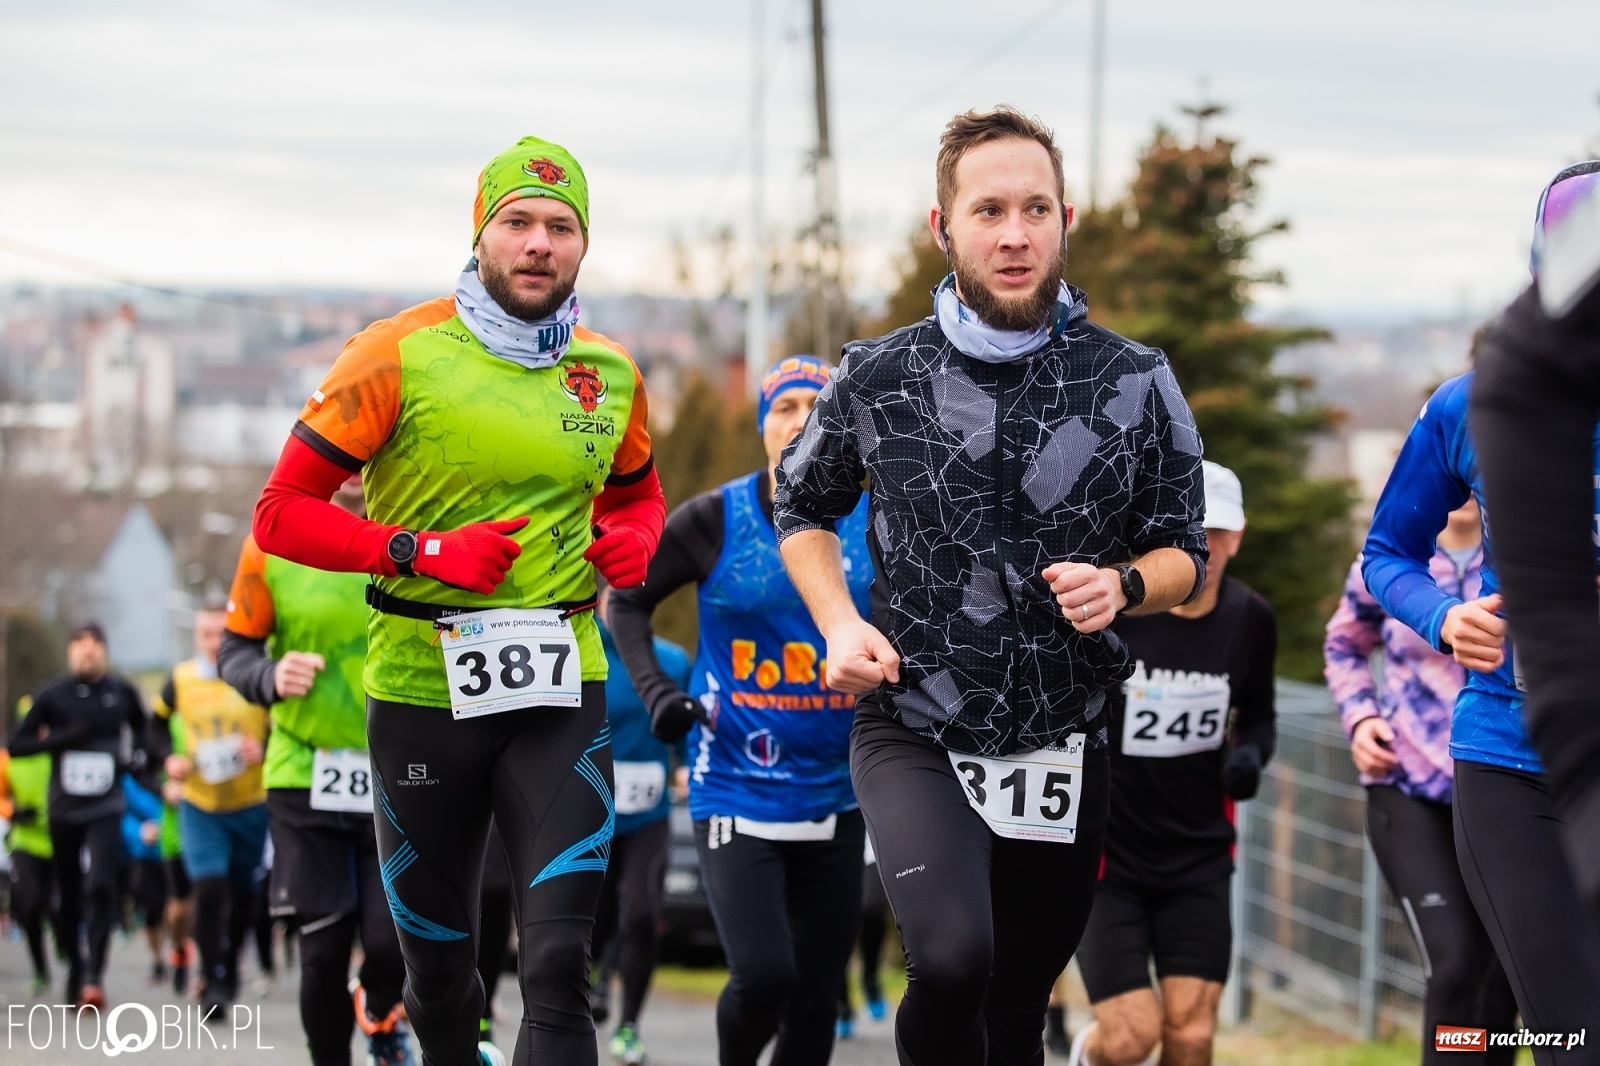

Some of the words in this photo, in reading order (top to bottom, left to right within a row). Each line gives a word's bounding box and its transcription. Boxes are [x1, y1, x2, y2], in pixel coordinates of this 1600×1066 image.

[560, 412, 615, 424] NAPALONE
[562, 420, 615, 437] DZIKI
[455, 643, 571, 697] 387
[1132, 708, 1221, 742] 245
[956, 760, 1072, 821] 315
